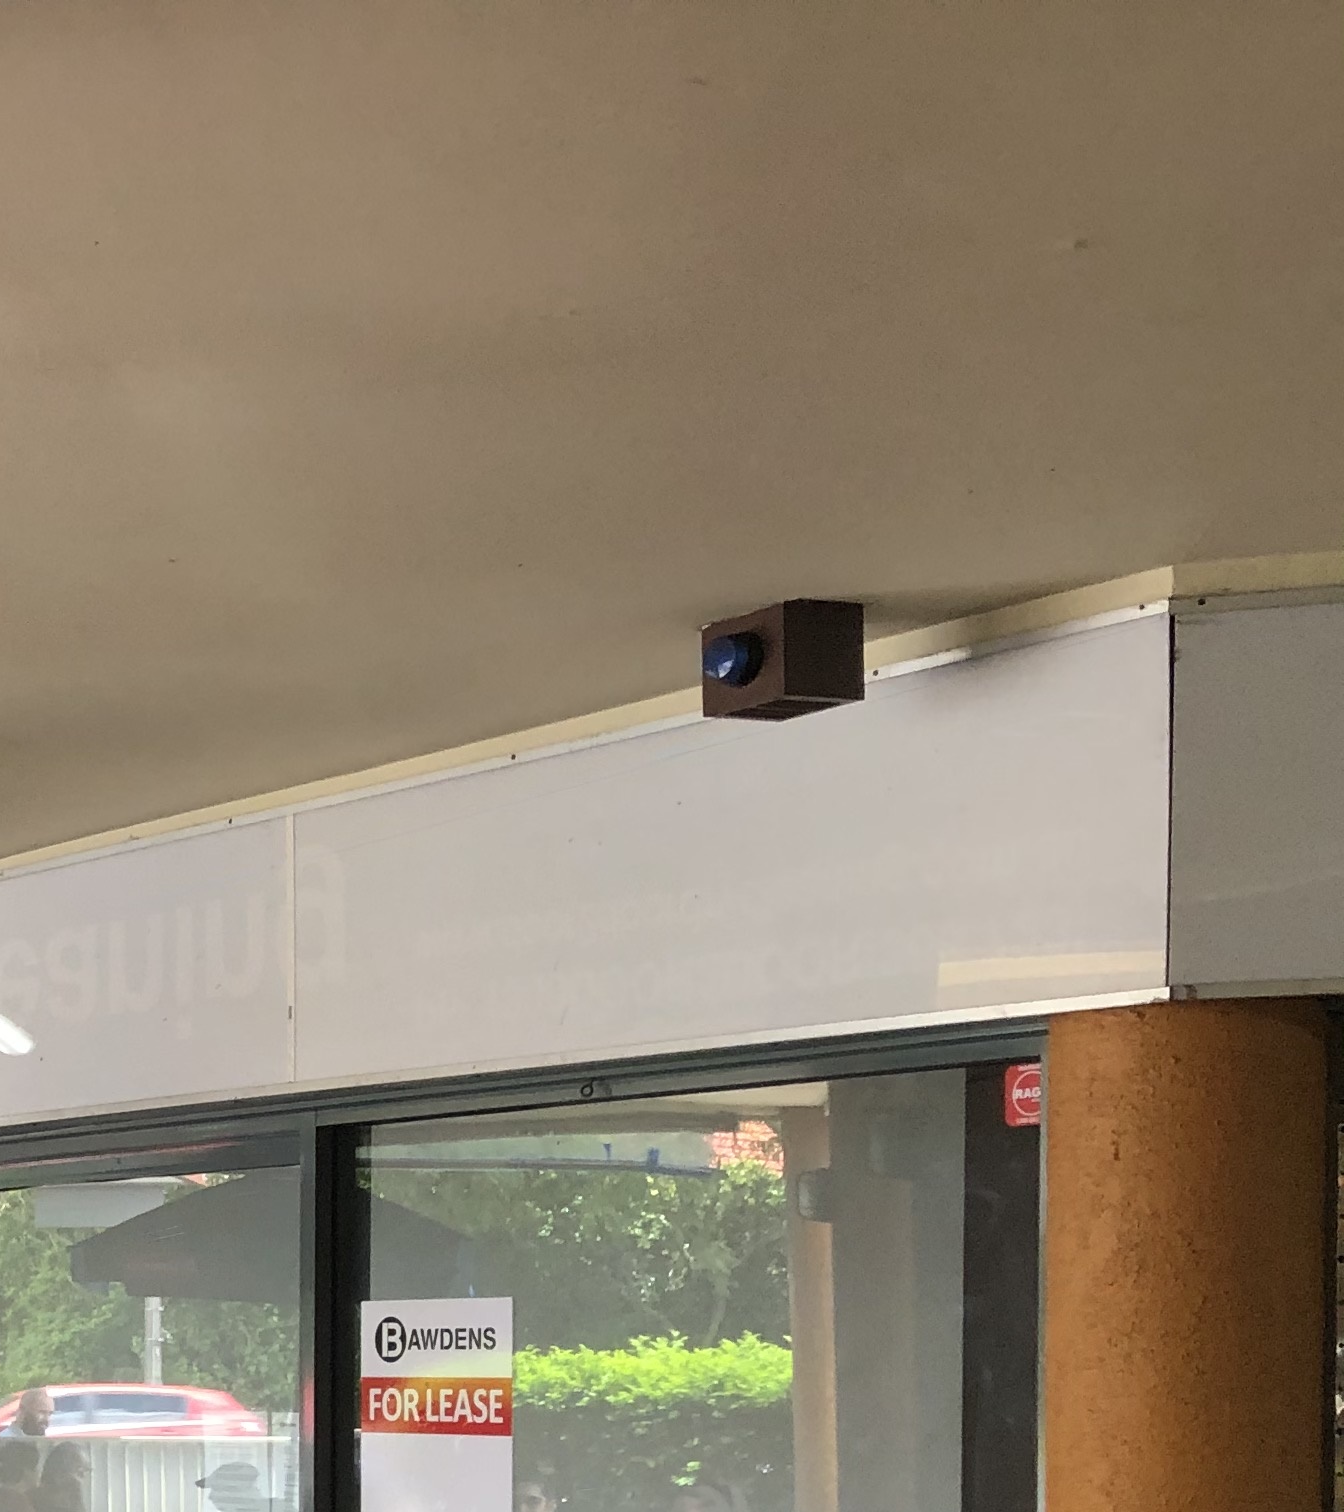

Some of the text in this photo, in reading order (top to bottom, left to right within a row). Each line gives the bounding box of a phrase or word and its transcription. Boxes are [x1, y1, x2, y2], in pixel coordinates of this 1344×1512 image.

[375, 1317, 497, 1363] BAWDENS
[368, 1387, 504, 1424] FOR LEASE
